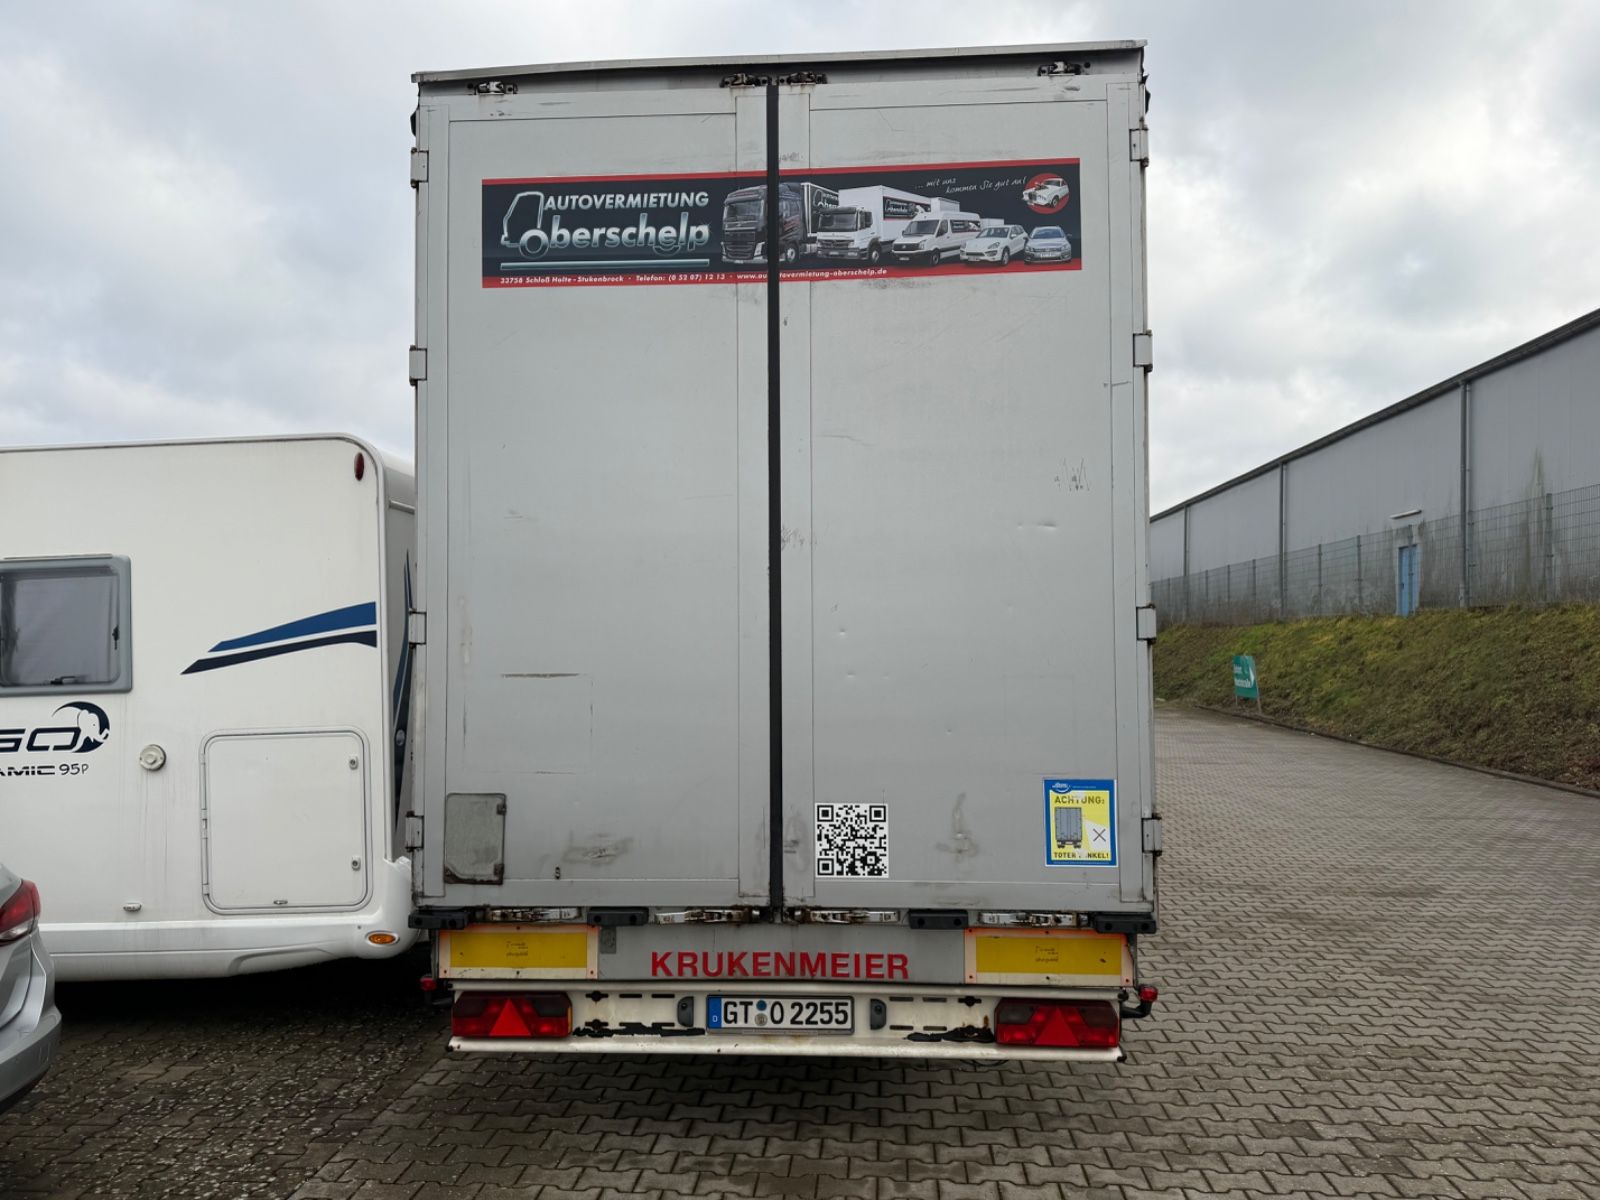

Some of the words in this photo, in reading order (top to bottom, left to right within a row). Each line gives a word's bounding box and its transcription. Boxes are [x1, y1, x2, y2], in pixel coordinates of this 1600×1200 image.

[926, 178, 940, 187] mit
[946, 185, 977, 194] kommen
[980, 180, 992, 191] Sie
[994, 179, 1009, 191] gut
[543, 191, 709, 211] AUTOVERMIETUNG
[0, 765, 55, 776] MIC
[59, 763, 89, 776] 95P
[651, 951, 909, 980] KRUKENMEIER
[723, 1001, 753, 1024] GT
[790, 1002, 849, 1025] 2255
